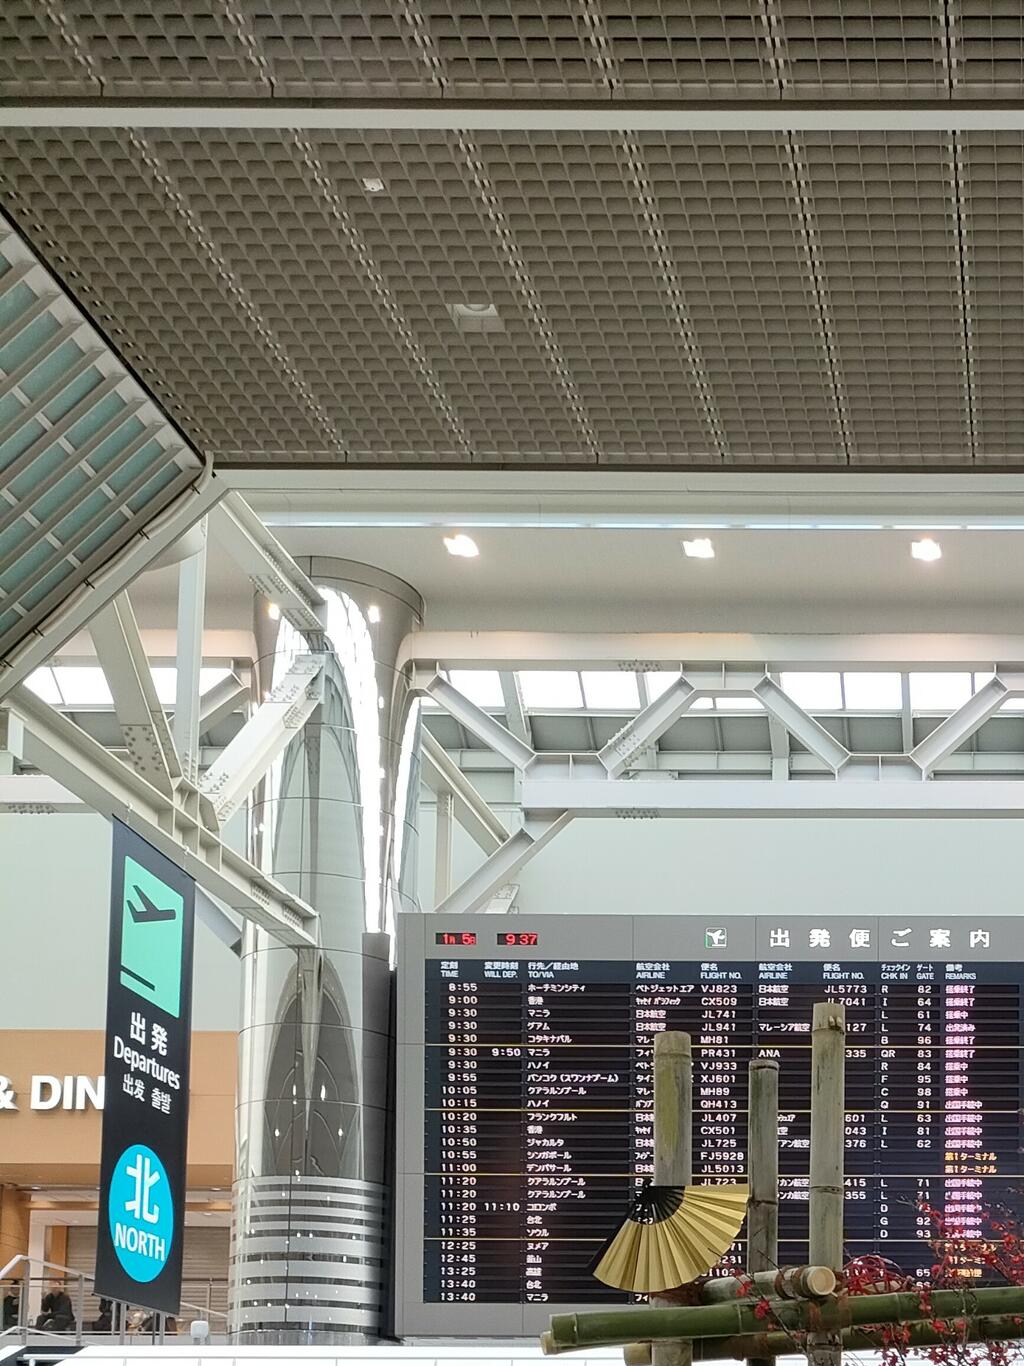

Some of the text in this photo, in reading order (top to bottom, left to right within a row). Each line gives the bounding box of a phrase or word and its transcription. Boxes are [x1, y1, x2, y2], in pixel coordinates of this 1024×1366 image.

[769, 928, 990, 949] 出発便ご案内
[701, 963, 717, 971] 便名
[449, 983, 477, 991] 8:55
[701, 985, 737, 993] VJ823
[824, 985, 867, 993] JL5773
[449, 996, 931, 1006] 9:00 CX509 64
[449, 1009, 477, 1017] 9:30
[702, 1010, 735, 1018] JL741
[918, 1011, 929, 1019] 61
[527, 1022, 550, 1030] グアム
[702, 1023, 735, 1031] JL941
[130, 1011, 168, 1057] 出発
[449, 1034, 477, 1042] 9:30
[918, 1036, 931, 1044] 96
[449, 1048, 477, 1056] 9:30
[492, 1048, 520, 1056] 9:50
[701, 1049, 735, 1057] PR431
[113, 1035, 180, 1090] Departures
[526, 1062, 549, 1071] ハノイ
[701, 1062, 736, 1070] VJ933
[448, 1073, 931, 1083] 9:55 XJ601 95
[122, 1073, 146, 1102] 出发
[443, 1086, 477, 1094] 10:05
[443, 1099, 476, 1107] 10:15
[701, 1100, 736, 1108] QH413
[443, 1113, 736, 1122] 10:20 フランクフルト JL407
[443, 1125, 476, 1133] 10:35
[443, 1138, 564, 1146] 10:50 ジャカルタ
[442, 1151, 571, 1159] 10:55 シンガポール
[440, 1164, 476, 1174] 11:00
[124, 1154, 160, 1224] 北
[114, 1224, 165, 1262] NORTH
